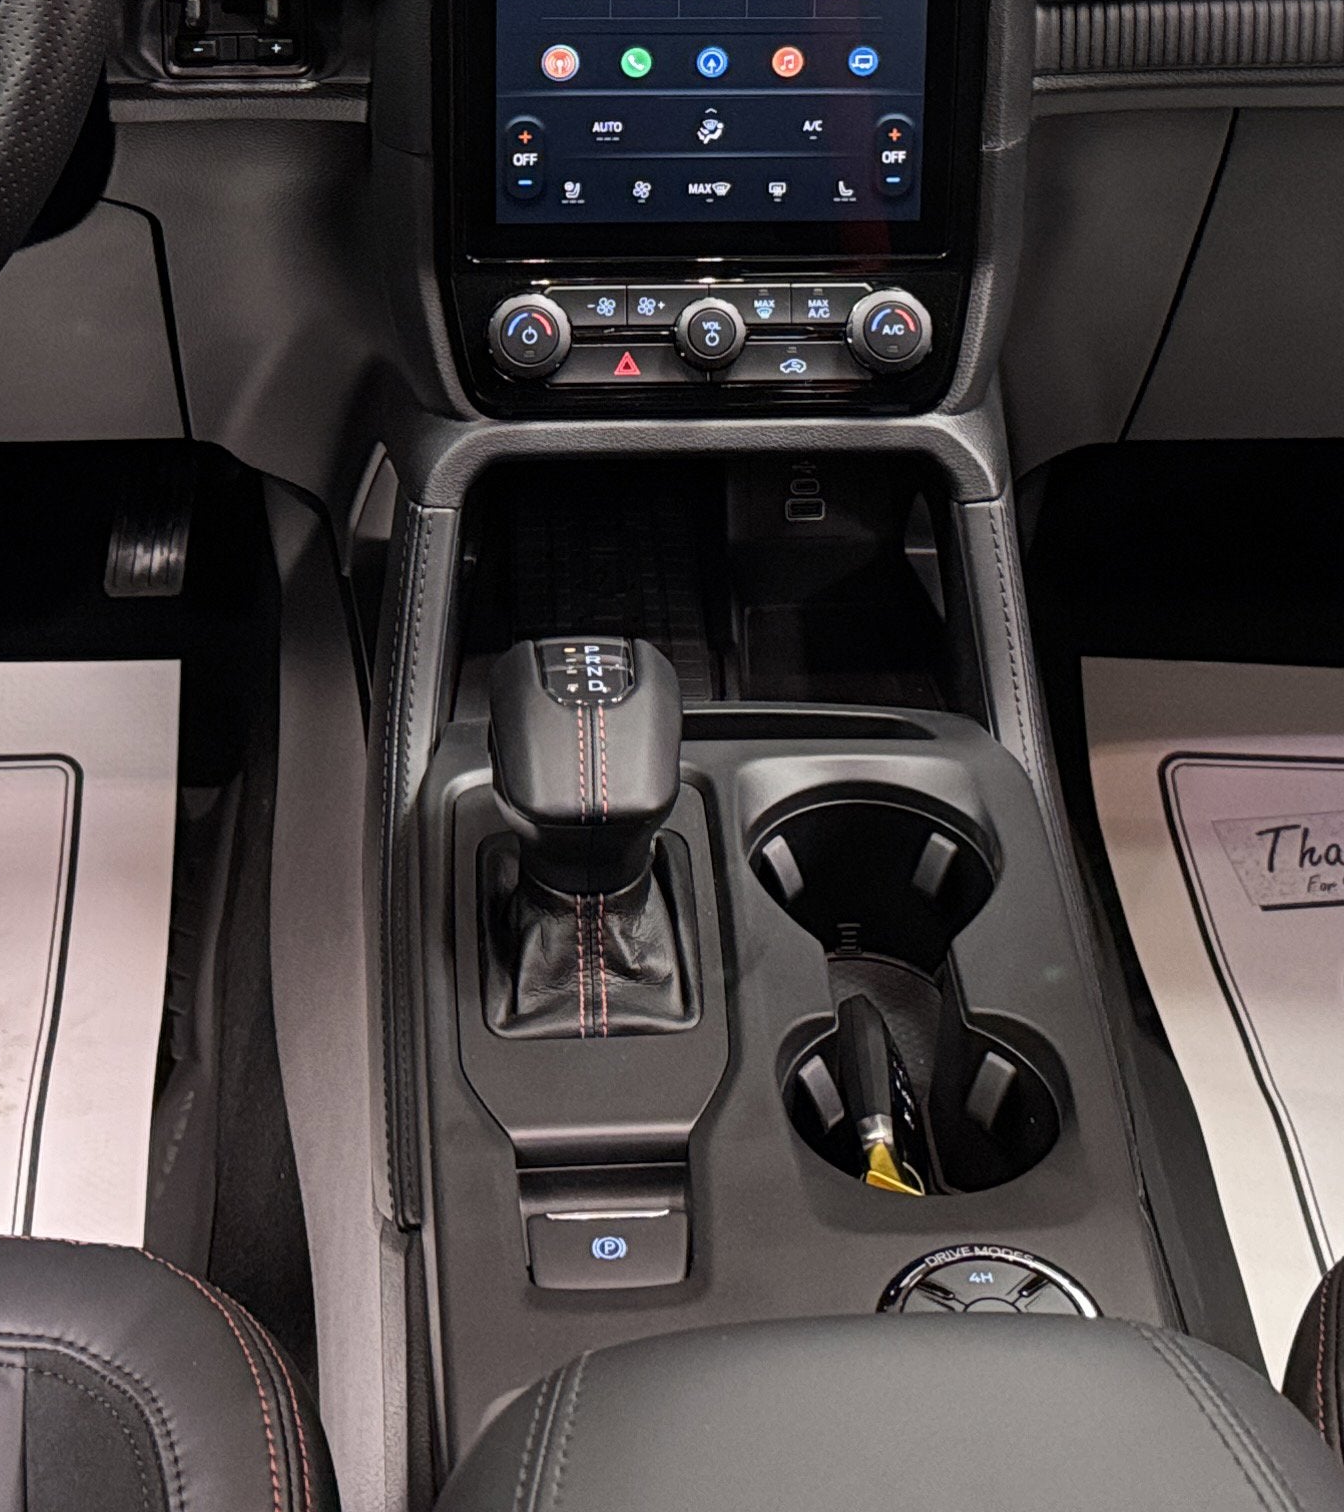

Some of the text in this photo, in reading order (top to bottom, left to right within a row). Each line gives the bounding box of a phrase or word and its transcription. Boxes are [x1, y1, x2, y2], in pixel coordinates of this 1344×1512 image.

[592, 120, 623, 134] AUTO
[802, 120, 823, 133] A/C
[512, 153, 538, 167] OFF
[881, 151, 906, 164] OFF
[688, 183, 712, 195] MAX
[754, 299, 775, 308] MAX
[807, 299, 829, 308] MAX
[807, 307, 830, 319] A/C
[702, 321, 722, 331] VOL
[881, 324, 905, 336] A/C
[584, 645, 600, 654] P
[585, 655, 601, 665] R
[587, 666, 603, 677] N
[588, 680, 605, 692] D
[1307, 874, 1337, 894] For
[924, 1245, 1036, 1267] DRIVE MODES
[968, 1272, 995, 1284] 4H
